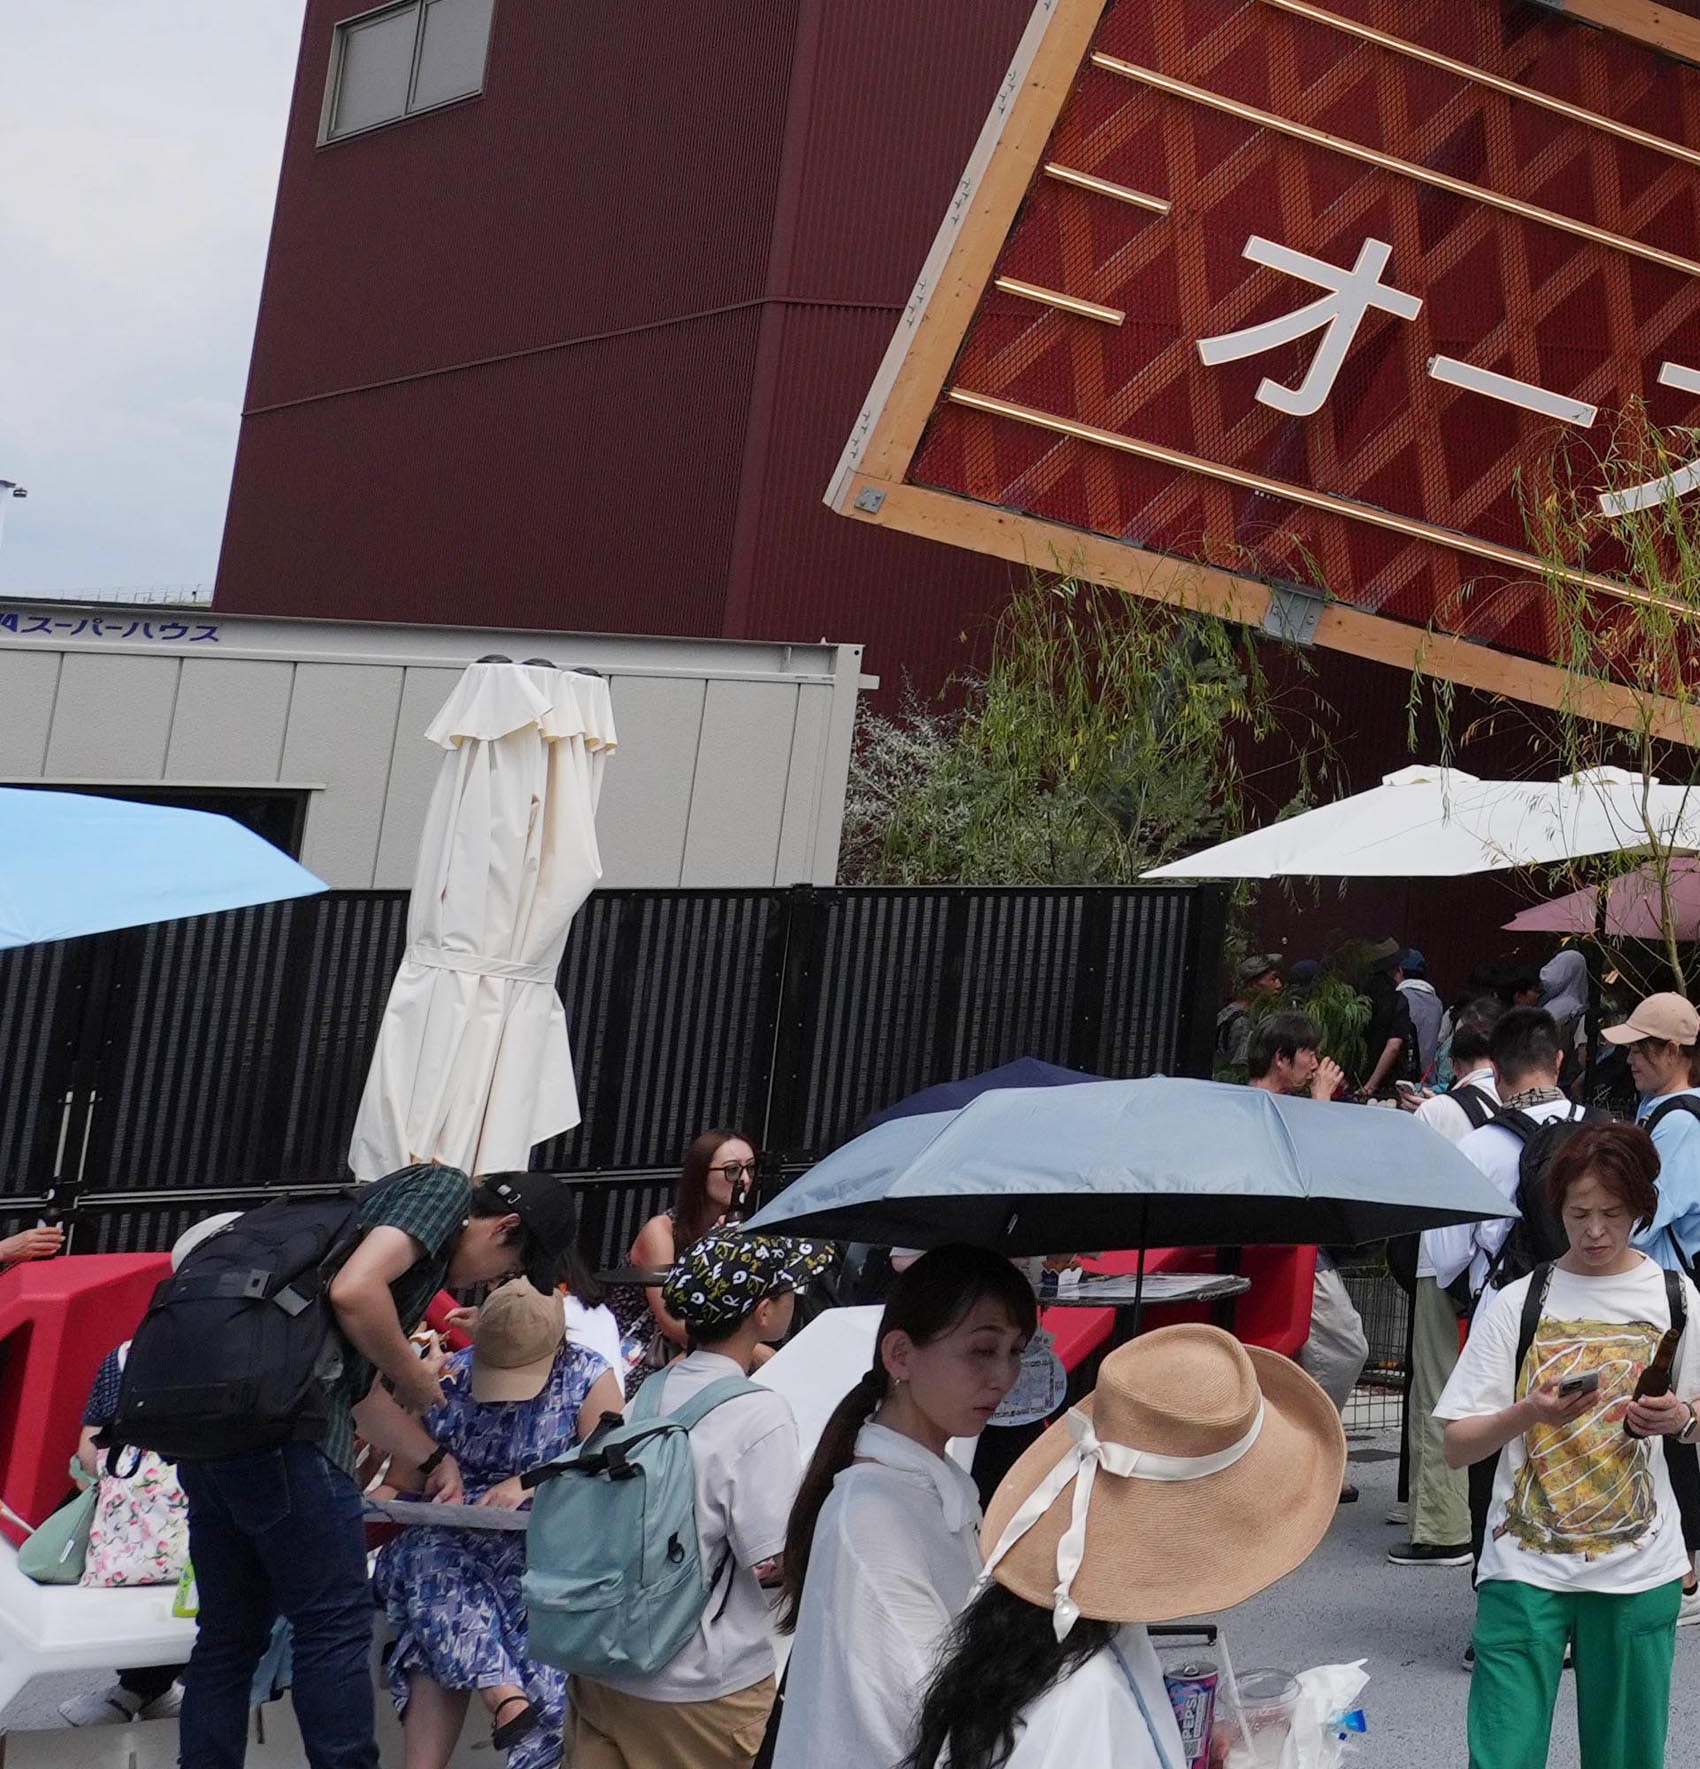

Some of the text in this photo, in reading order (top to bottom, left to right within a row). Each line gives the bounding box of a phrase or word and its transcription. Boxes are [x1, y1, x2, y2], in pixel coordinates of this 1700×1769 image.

[20, 616, 220, 642] スーパーハウス
